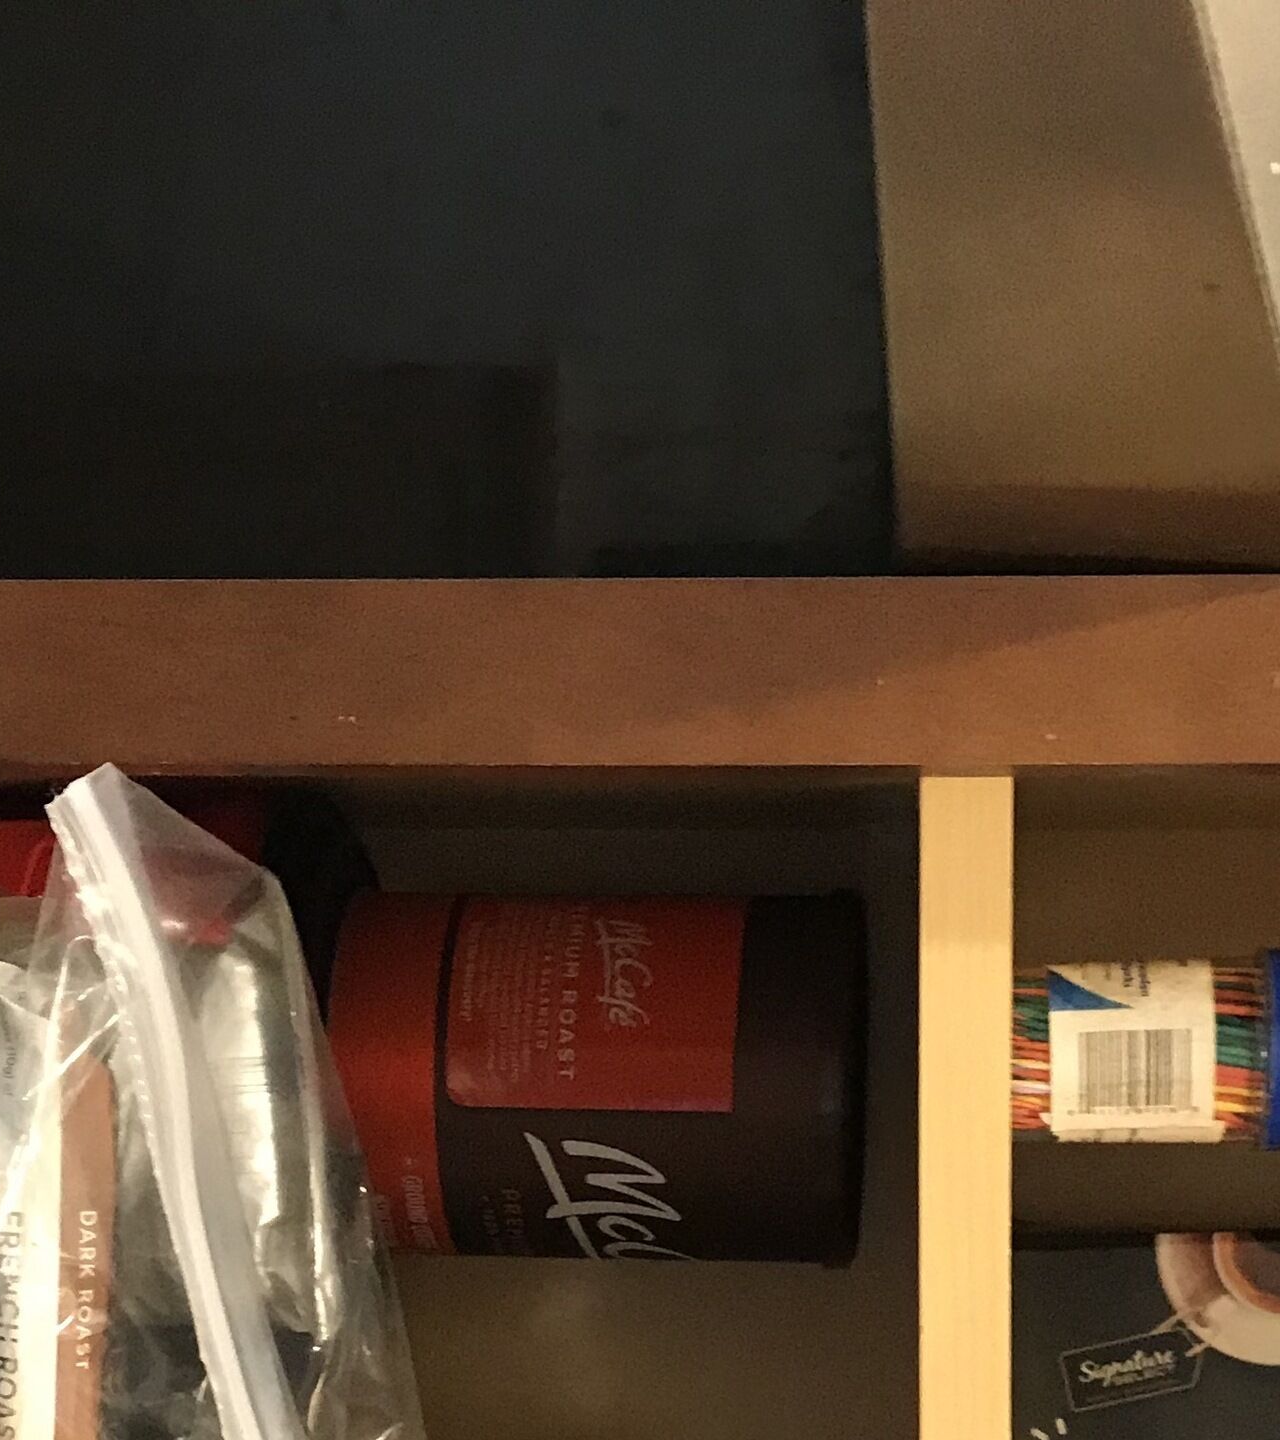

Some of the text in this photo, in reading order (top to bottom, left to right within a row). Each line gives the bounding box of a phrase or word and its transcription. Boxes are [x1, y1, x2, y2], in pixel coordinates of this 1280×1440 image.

[557, 989, 579, 1081] ROAST
[75, 1210, 98, 1370] DARK ROAST
[1078, 1349, 1175, 1388] Signature
